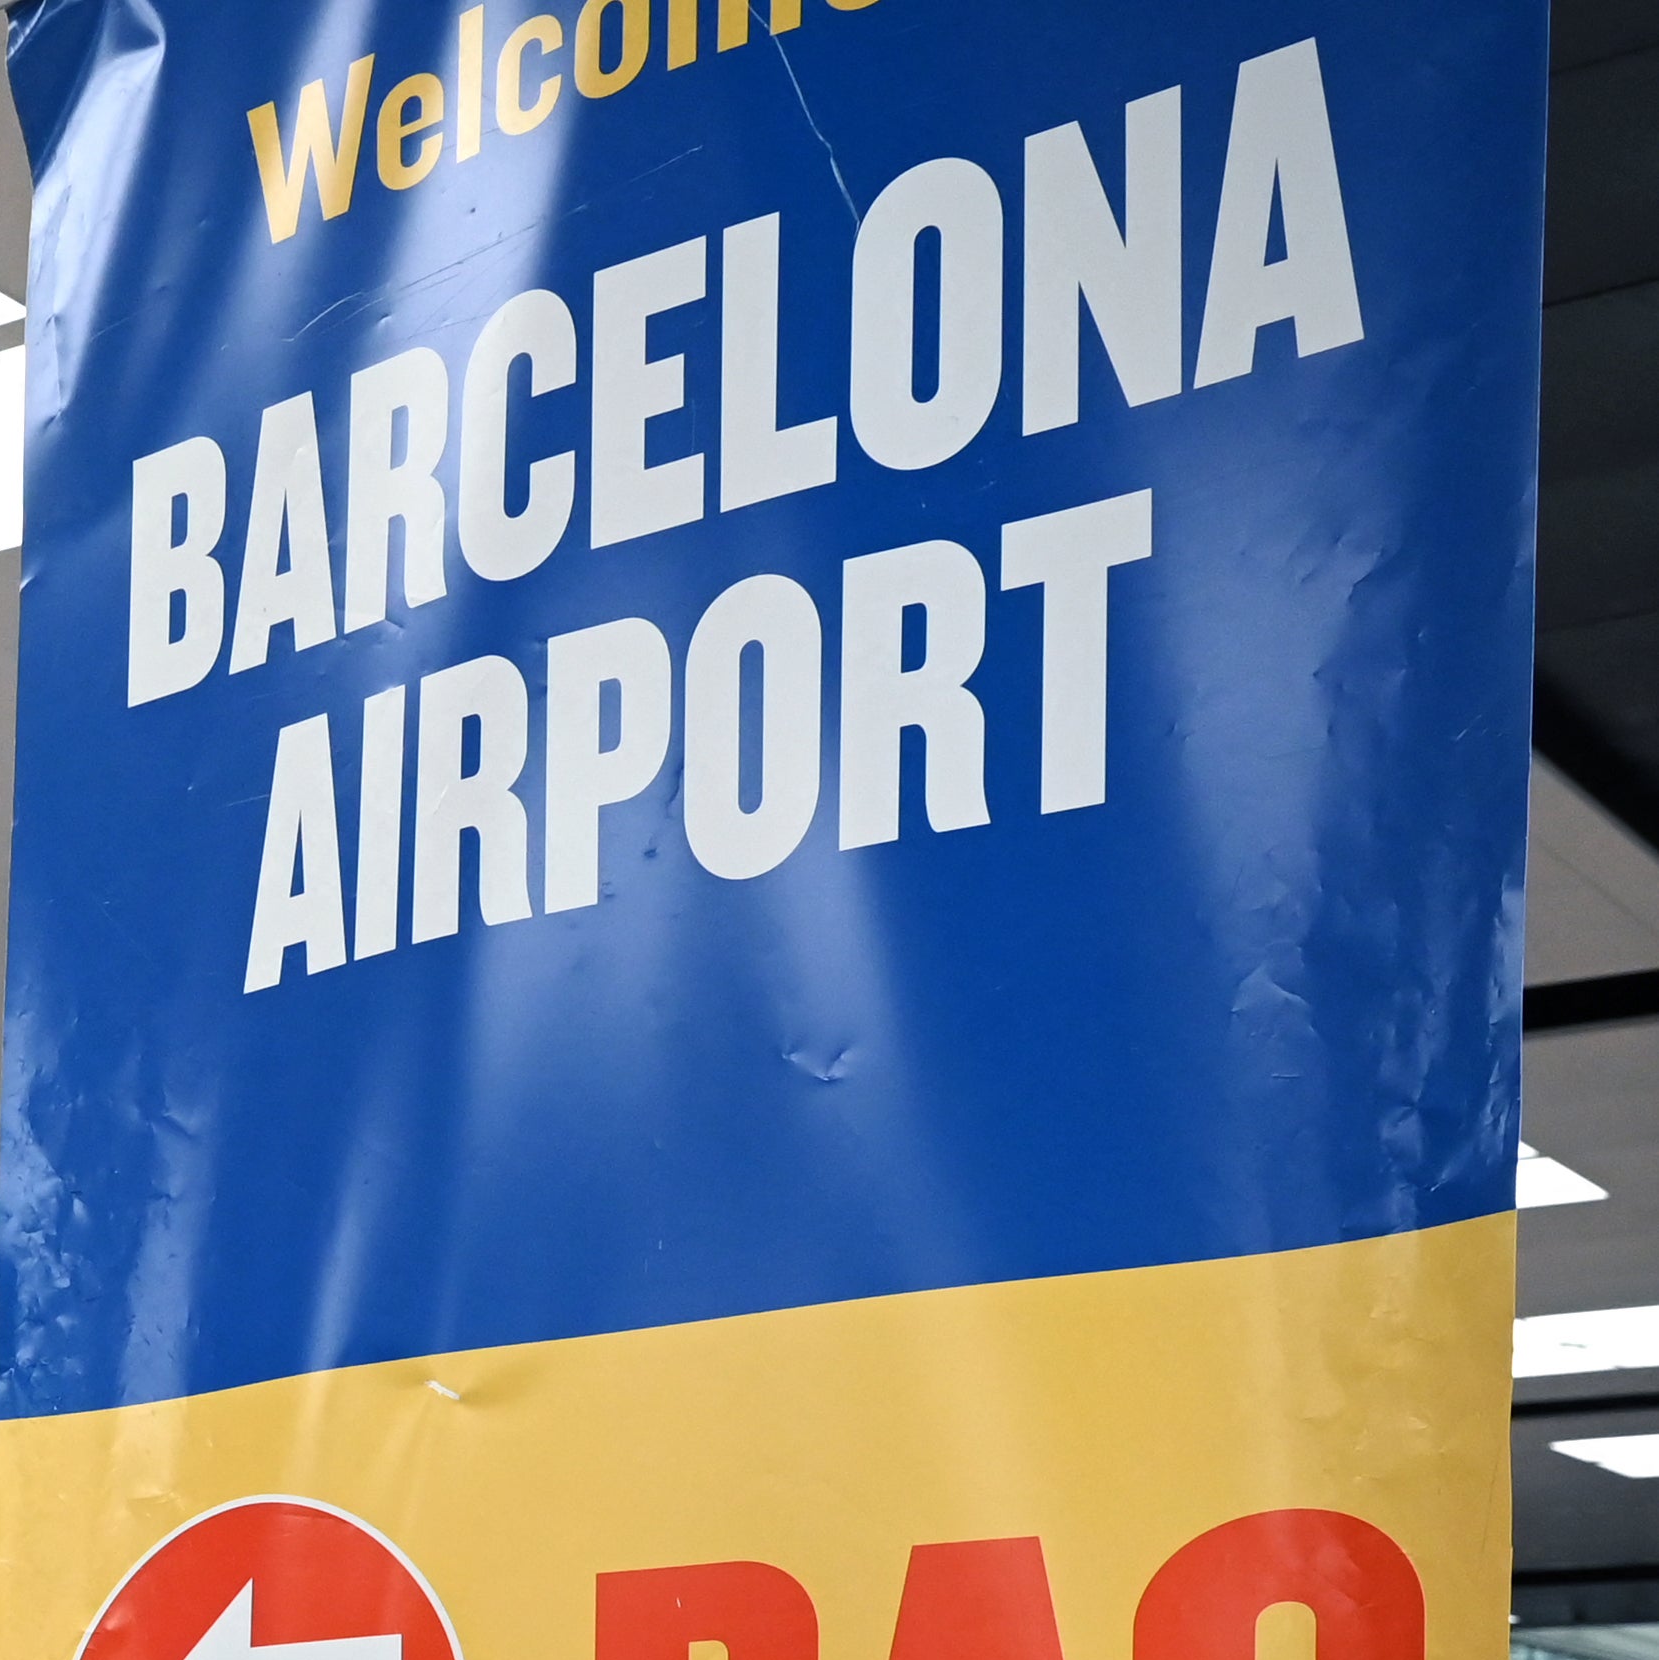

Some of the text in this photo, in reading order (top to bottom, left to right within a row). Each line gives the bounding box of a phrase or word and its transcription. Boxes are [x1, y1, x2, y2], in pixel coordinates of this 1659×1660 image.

[126, 36, 1365, 708] BARCELONA
[247, 0, 884, 245] Welco
[242, 487, 1152, 995] AIRPORT
